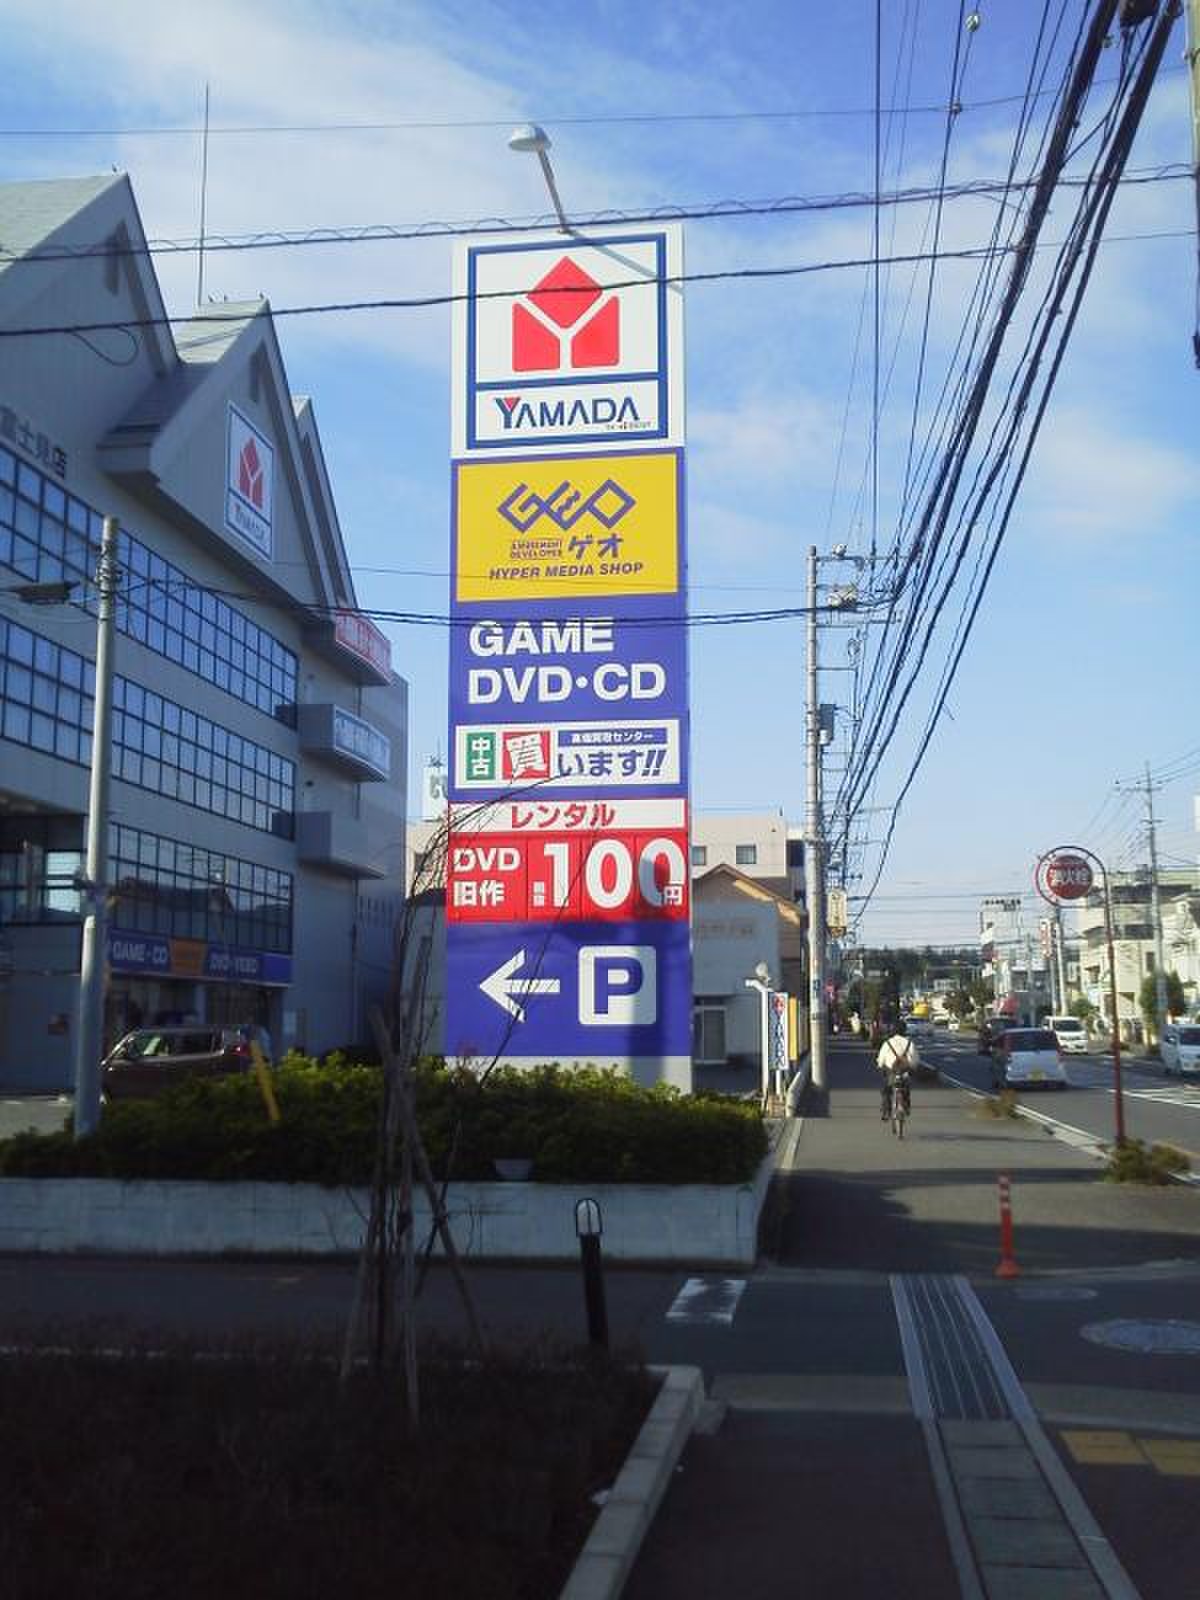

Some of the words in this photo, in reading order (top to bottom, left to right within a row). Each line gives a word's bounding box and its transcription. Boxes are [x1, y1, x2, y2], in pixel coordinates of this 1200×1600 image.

[495, 396, 640, 429] YAMADA
[498, 478, 637, 533] GEO
[567, 533, 624, 560] ゲオ
[489, 567, 541, 580] HYPER
[544, 565, 594, 577] MEDIA
[599, 562, 644, 576] SHOP
[469, 616, 614, 657] GAME
[471, 737, 491, 776] 中古
[511, 803, 616, 829] レンタル
[452, 847, 521, 873] DVD
[452, 880, 505, 907] 旧作
[593, 956, 644, 1015] P
